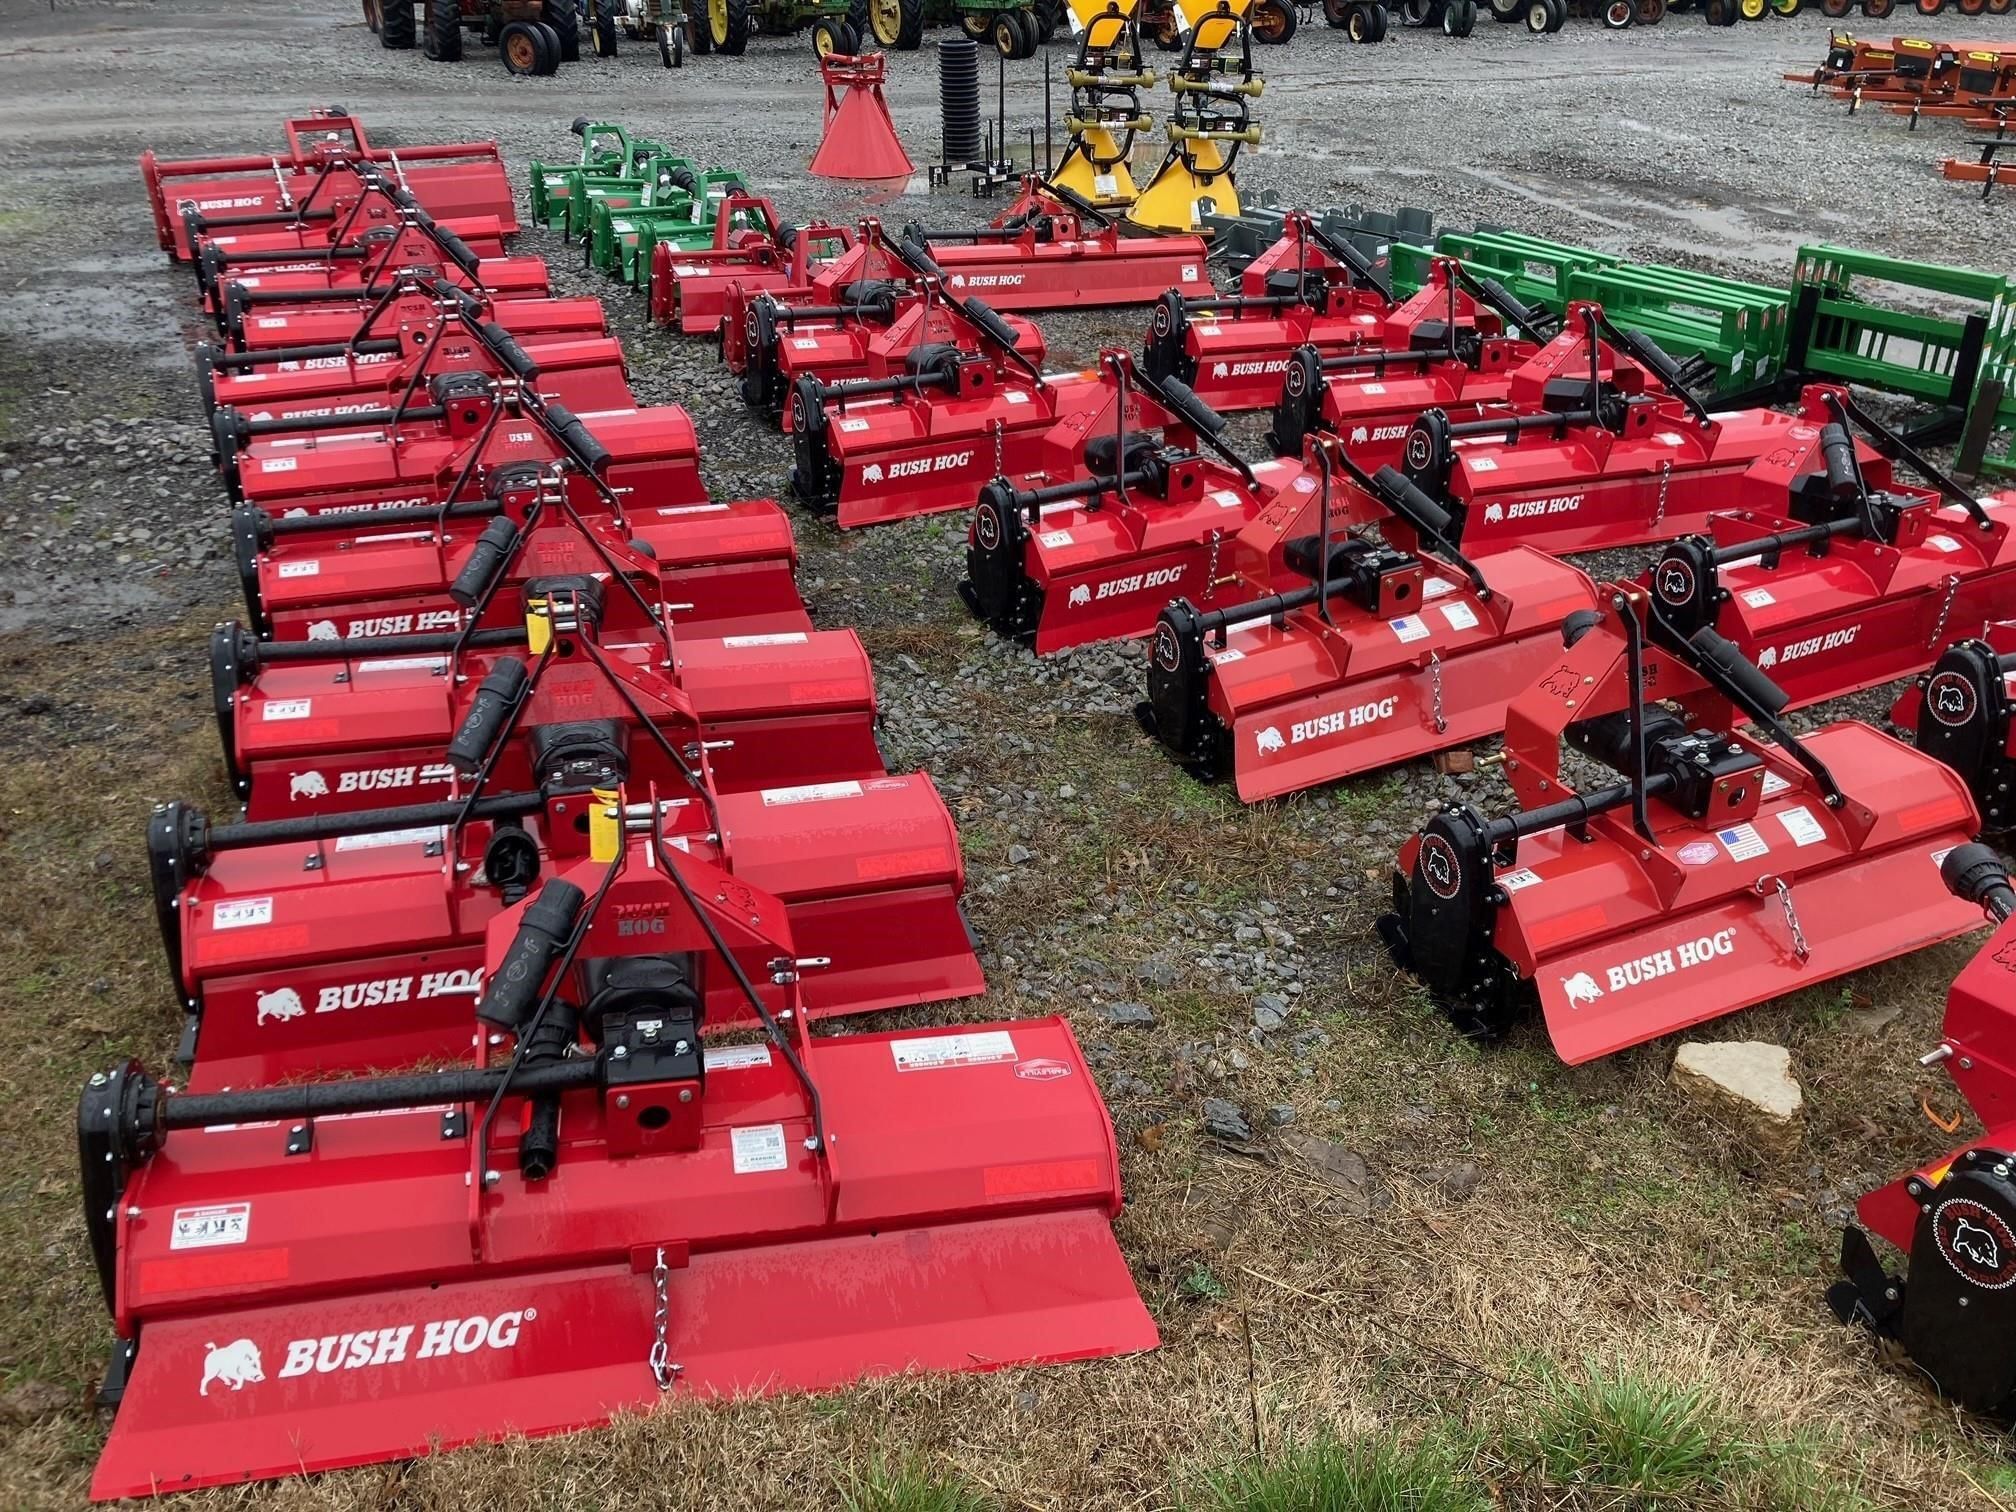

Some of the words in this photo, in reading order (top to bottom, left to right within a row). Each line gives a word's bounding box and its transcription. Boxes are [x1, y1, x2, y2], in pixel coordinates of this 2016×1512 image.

[199, 199, 232, 210] BUSH
[233, 196, 261, 207] HOG
[968, 276, 996, 287] BUSH
[303, 356, 347, 371] BUSH
[1231, 363, 1264, 377] BUSH
[1371, 425, 1408, 442] BUSH
[887, 459, 932, 479] BUSH
[1507, 501, 1548, 520] BUSH
[1096, 575, 1143, 600] BUSH
[347, 615, 412, 640] BUSH
[1780, 639, 1823, 663] BUSH
[1291, 711, 1345, 744] BUSH
[338, 764, 415, 793] BUSH
[618, 918, 665, 937] HOG
[1605, 951, 1675, 992] BUSH
[315, 975, 415, 1014] BUSH
[1943, 1203, 1981, 1221] BUSH
[1984, 1216, 2014, 1250] HOG
[278, 1326, 414, 1379] BUSH
